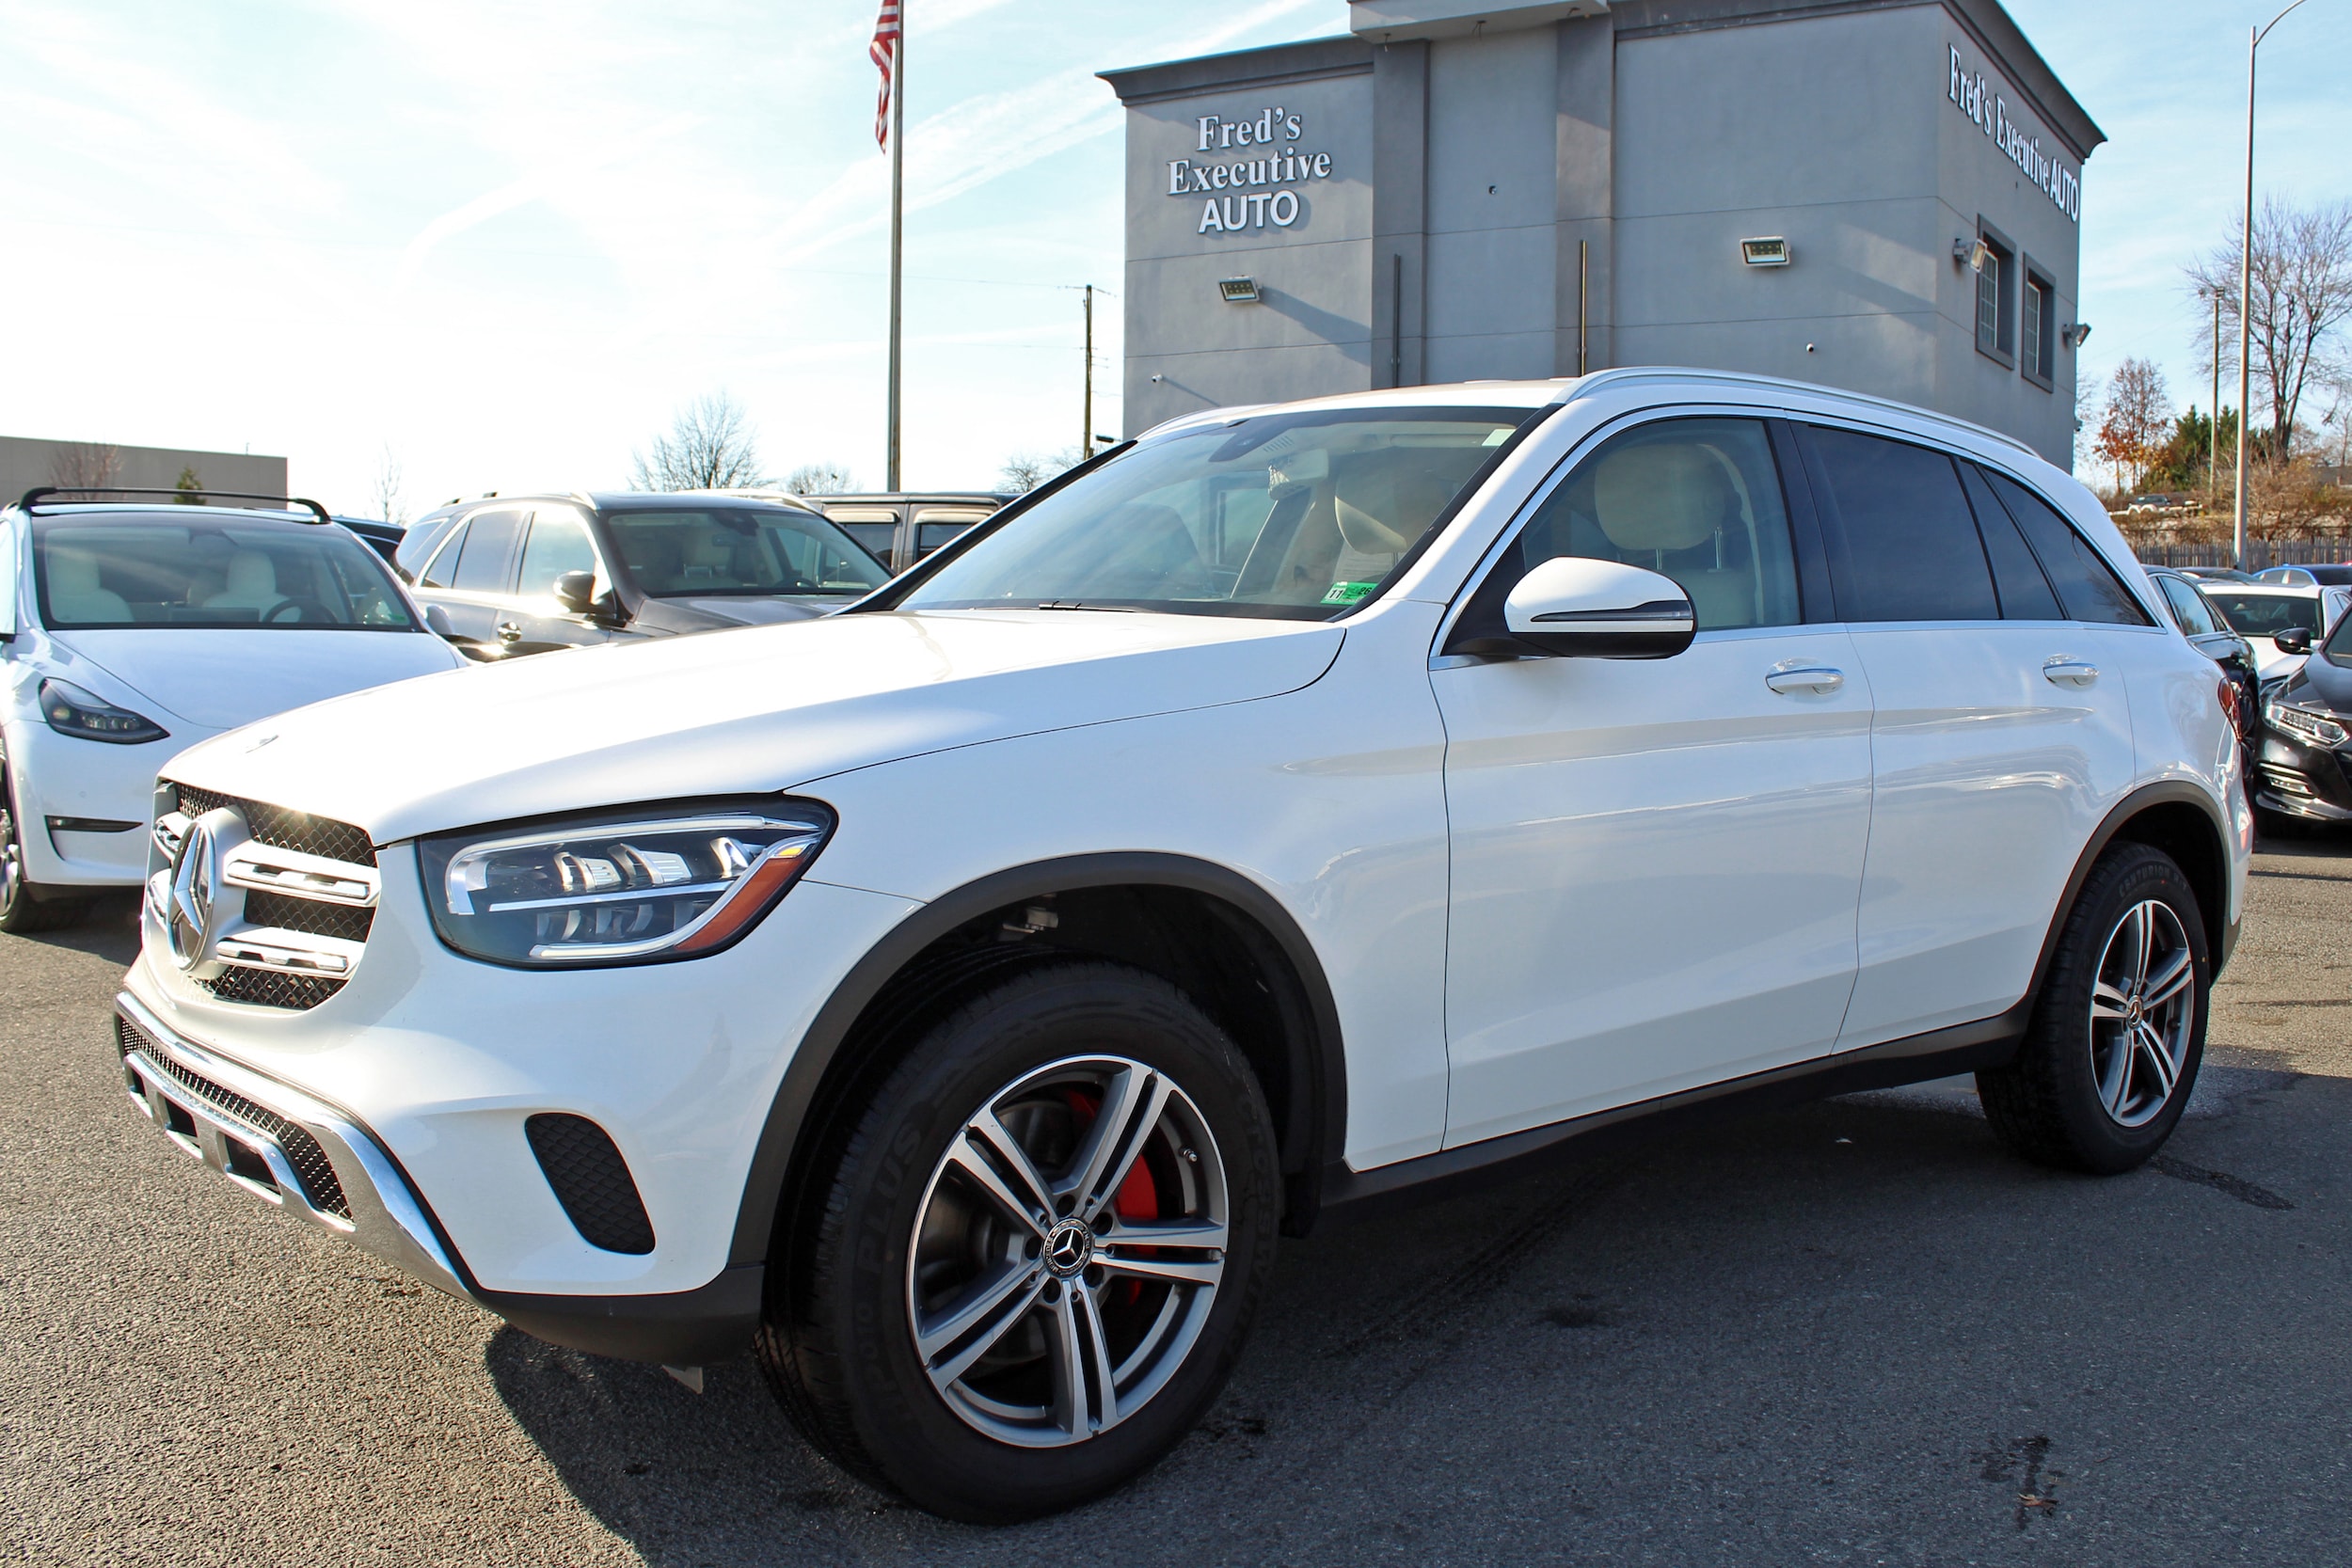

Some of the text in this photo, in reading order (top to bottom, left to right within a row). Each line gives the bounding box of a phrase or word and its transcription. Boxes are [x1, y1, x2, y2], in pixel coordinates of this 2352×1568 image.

[1196, 106, 1302, 151] Fred's
[1948, 43, 2079, 222] Fred's Executive AUTO
[1167, 147, 1331, 196] Executive
[1198, 190, 1300, 234] AUTO
[1329, 589, 1344, 599] 11
[1358, 586, 1373, 595] 26
[858, 1121, 921, 1273] PLUS
